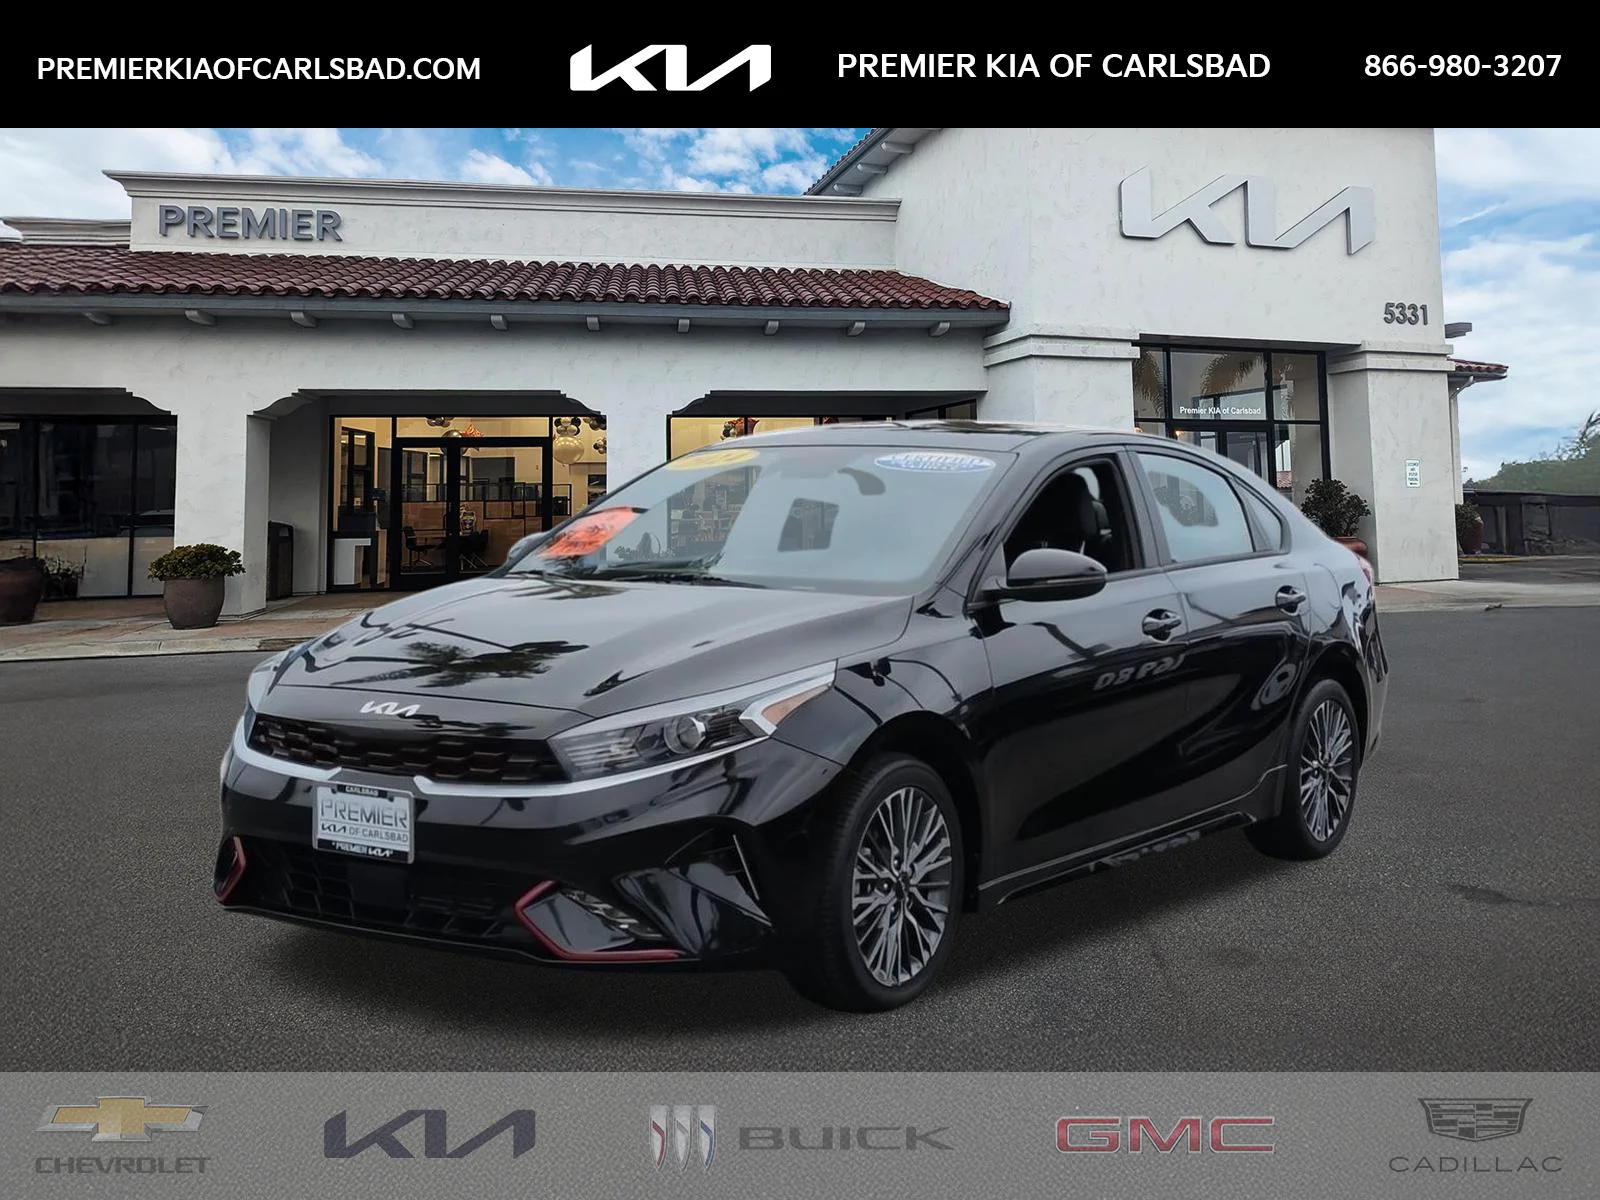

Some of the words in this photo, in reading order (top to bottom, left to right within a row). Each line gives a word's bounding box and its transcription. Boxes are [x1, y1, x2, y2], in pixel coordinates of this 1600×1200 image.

[159, 204, 343, 242] PREMIER
[1118, 166, 1375, 256] KIA
[1383, 302, 1429, 326] 5331
[1179, 406, 1208, 415] Premier
[1208, 407, 1221, 415] KIA
[1222, 406, 1230, 415] of
[1230, 407, 1262, 415] Carlsbad
[360, 700, 421, 717] KIA
[320, 798, 408, 829] PREMIER
[321, 822, 347, 833] KIA
[363, 828, 409, 843] CARLSBAD
